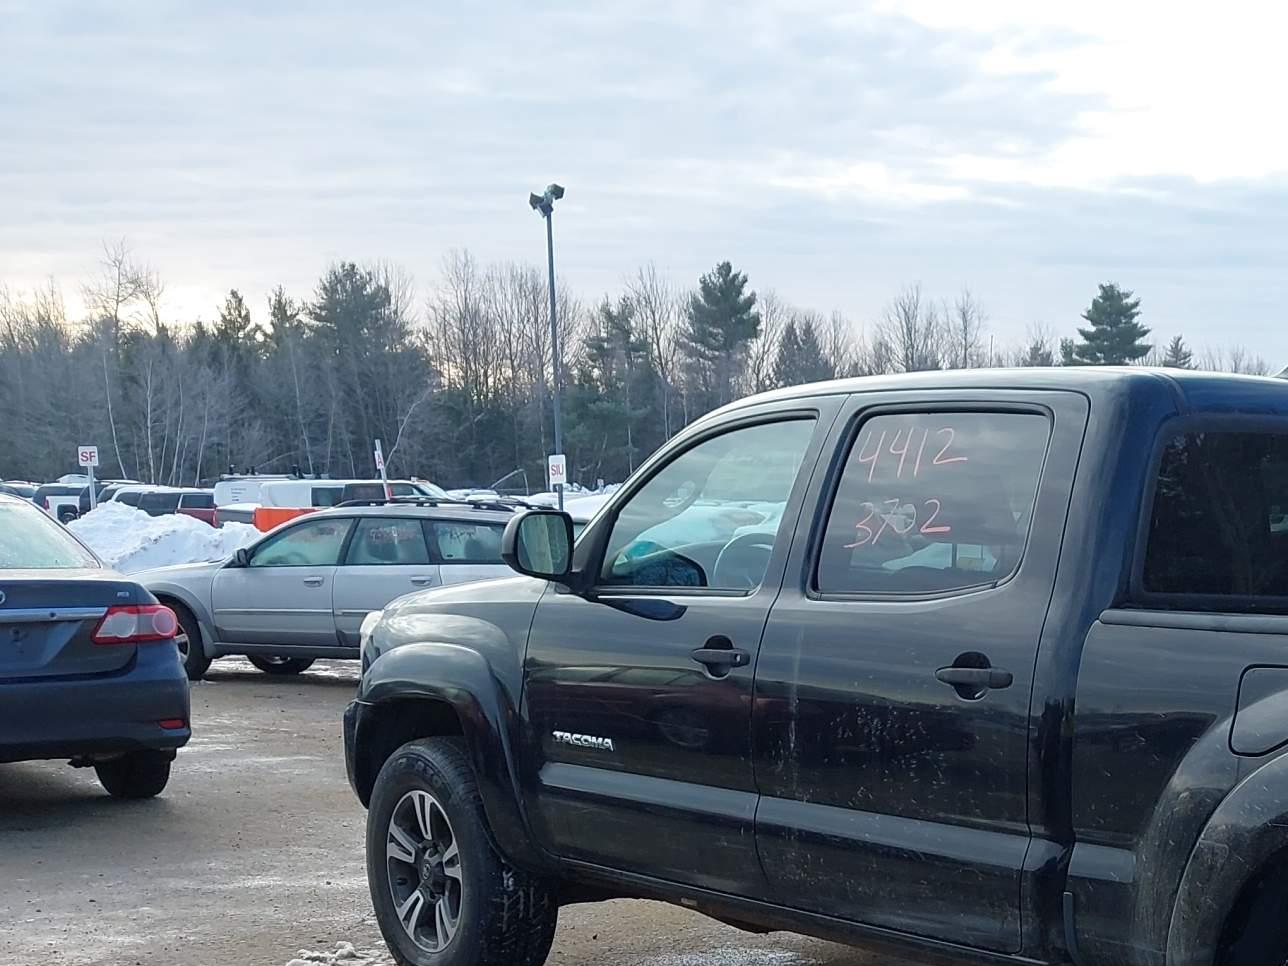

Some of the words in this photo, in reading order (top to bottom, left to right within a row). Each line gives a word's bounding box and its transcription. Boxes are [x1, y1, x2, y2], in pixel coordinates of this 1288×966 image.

[80, 451, 96, 462] SF
[859, 427, 968, 482] 4412
[551, 464, 564, 476] SIU
[843, 499, 951, 548] 3702
[552, 730, 614, 752] TACOMA
